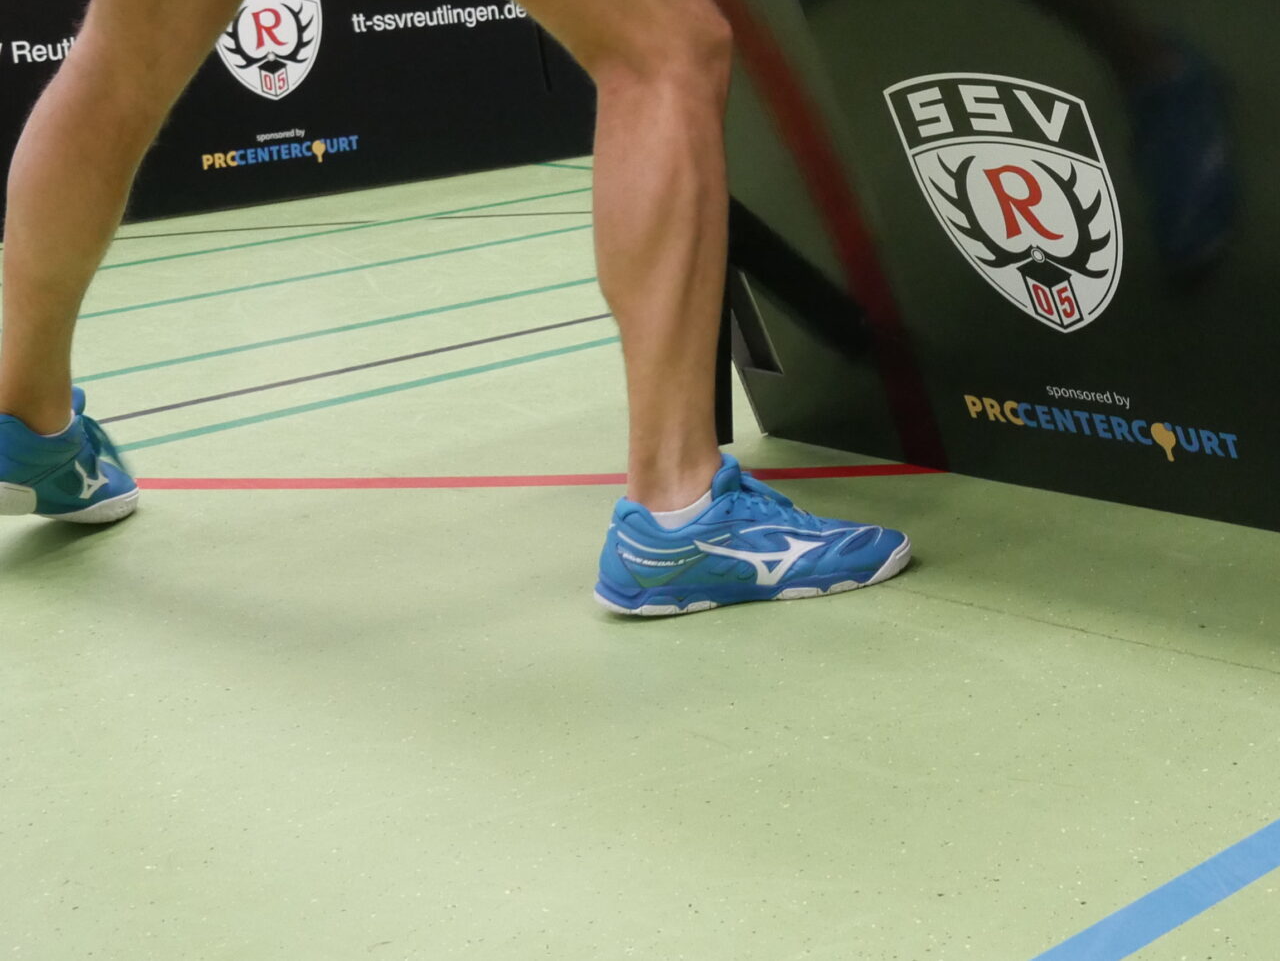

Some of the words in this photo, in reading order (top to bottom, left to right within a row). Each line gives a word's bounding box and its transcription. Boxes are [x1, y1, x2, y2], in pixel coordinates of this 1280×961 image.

[251, 8, 288, 50] R
[352, 0, 527, 33] tt-ssvreutlingen.de
[11, 36, 76, 64] Reut
[907, 84, 1070, 142] SSV
[256, 129, 295, 143] sponsored
[295, 127, 305, 139] by
[983, 165, 1064, 240] R
[1046, 384, 1112, 403] sponsored
[1111, 391, 1131, 409] by
